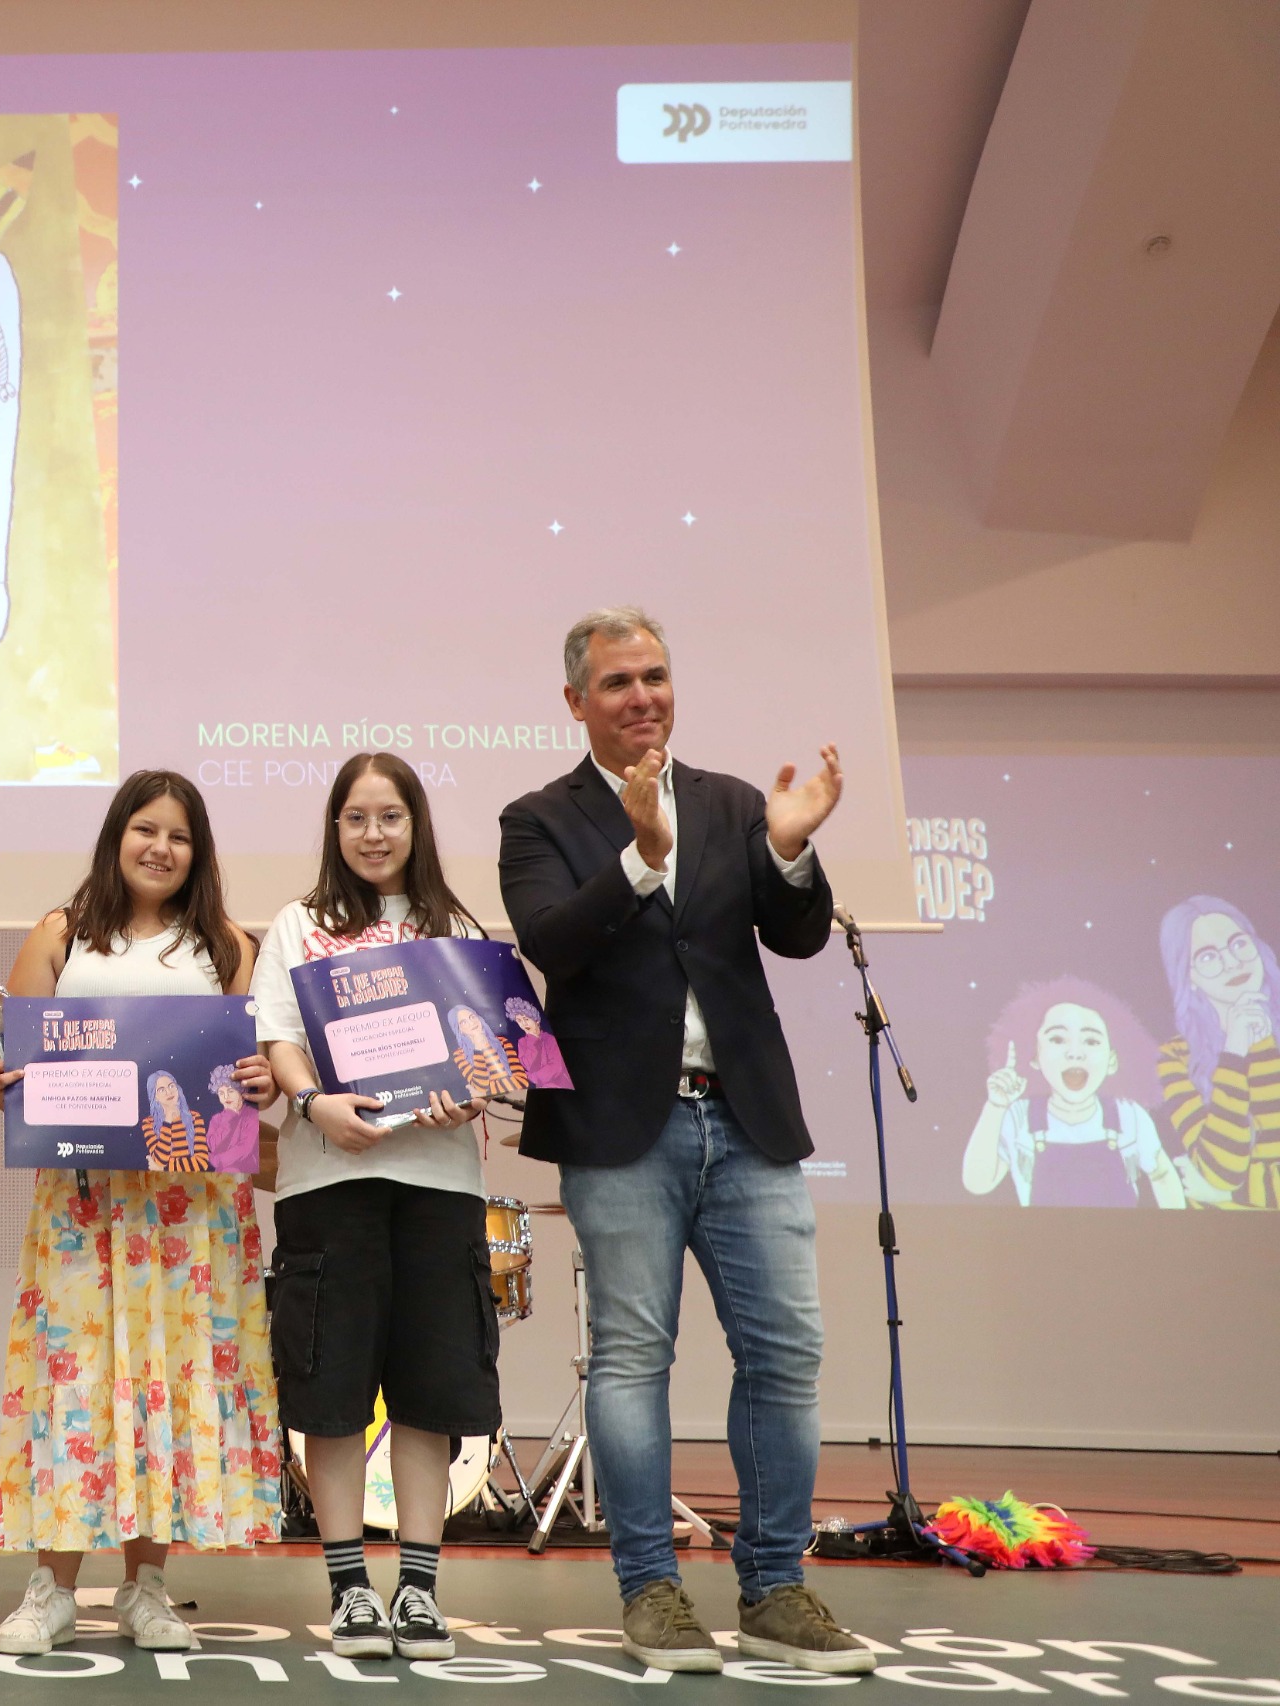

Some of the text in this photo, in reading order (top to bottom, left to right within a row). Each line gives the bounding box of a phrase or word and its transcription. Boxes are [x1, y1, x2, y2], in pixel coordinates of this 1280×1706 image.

[719, 105, 807, 118] Deputación
[719, 119, 807, 130] Pontevedra
[198, 717, 585, 750] MORENA RÍOS TONARELLI
[198, 760, 457, 787] CEE PONTRA
[906, 817, 988, 860] NSAS
[352, 973, 370, 992] QUE
[63, 1020, 80, 1040] QUE
[344, 1022, 380, 1034] PREMIO
[382, 1018, 393, 1027] EX
[43, 1069, 79, 1079] PREMIO
[82, 1069, 93, 1078] EX
[96, 1068, 132, 1078] AEQUO
